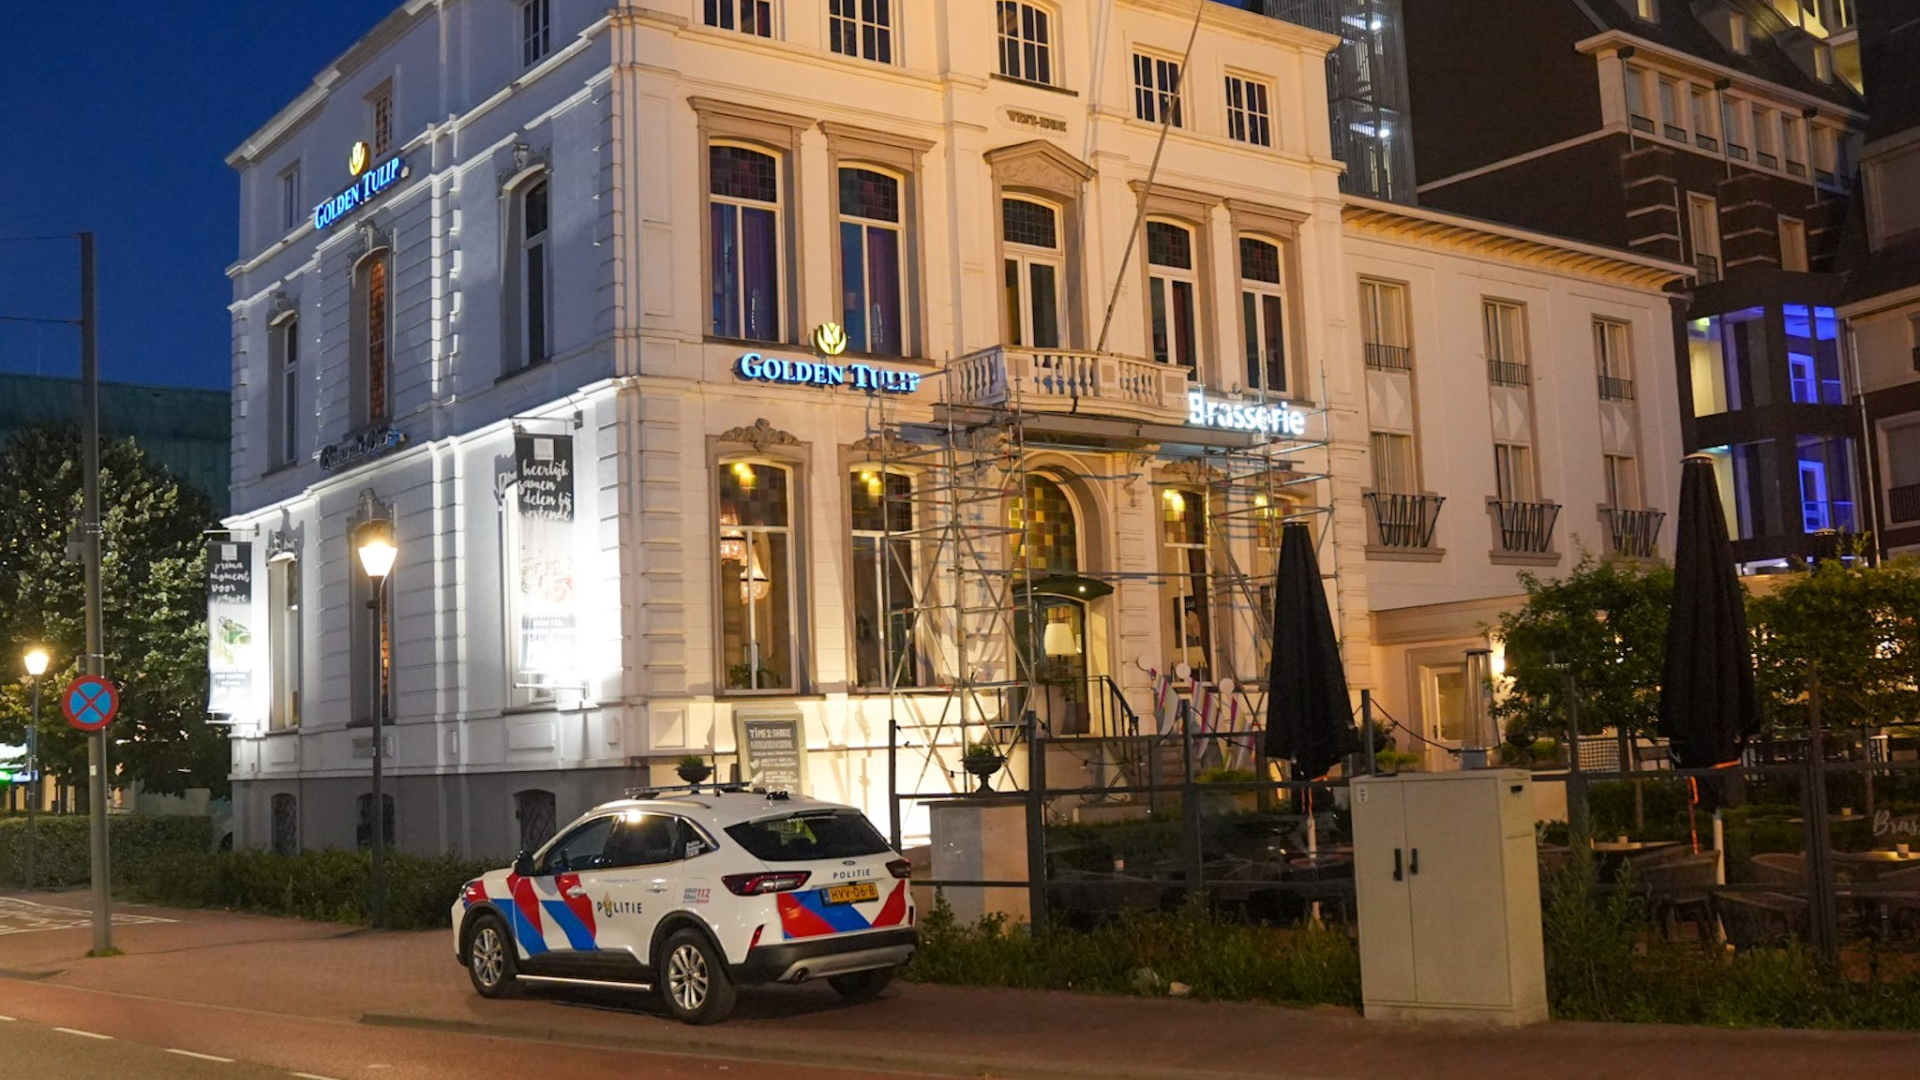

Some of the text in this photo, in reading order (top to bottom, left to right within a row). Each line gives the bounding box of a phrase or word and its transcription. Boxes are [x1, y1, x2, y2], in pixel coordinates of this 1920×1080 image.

[314, 157, 400, 229] GOLDEN TULIP
[741, 353, 921, 392] GOLDEN TULIP
[1188, 390, 1305, 435] Brasserie
[522, 459, 570, 482] heerlijk
[518, 480, 556, 495] samen
[523, 490, 572, 512] delen bij
[211, 583, 236, 592] voor
[833, 868, 871, 879] POLITIE
[697, 888, 711, 898] 112
[597, 893, 643, 918] POLITIE
